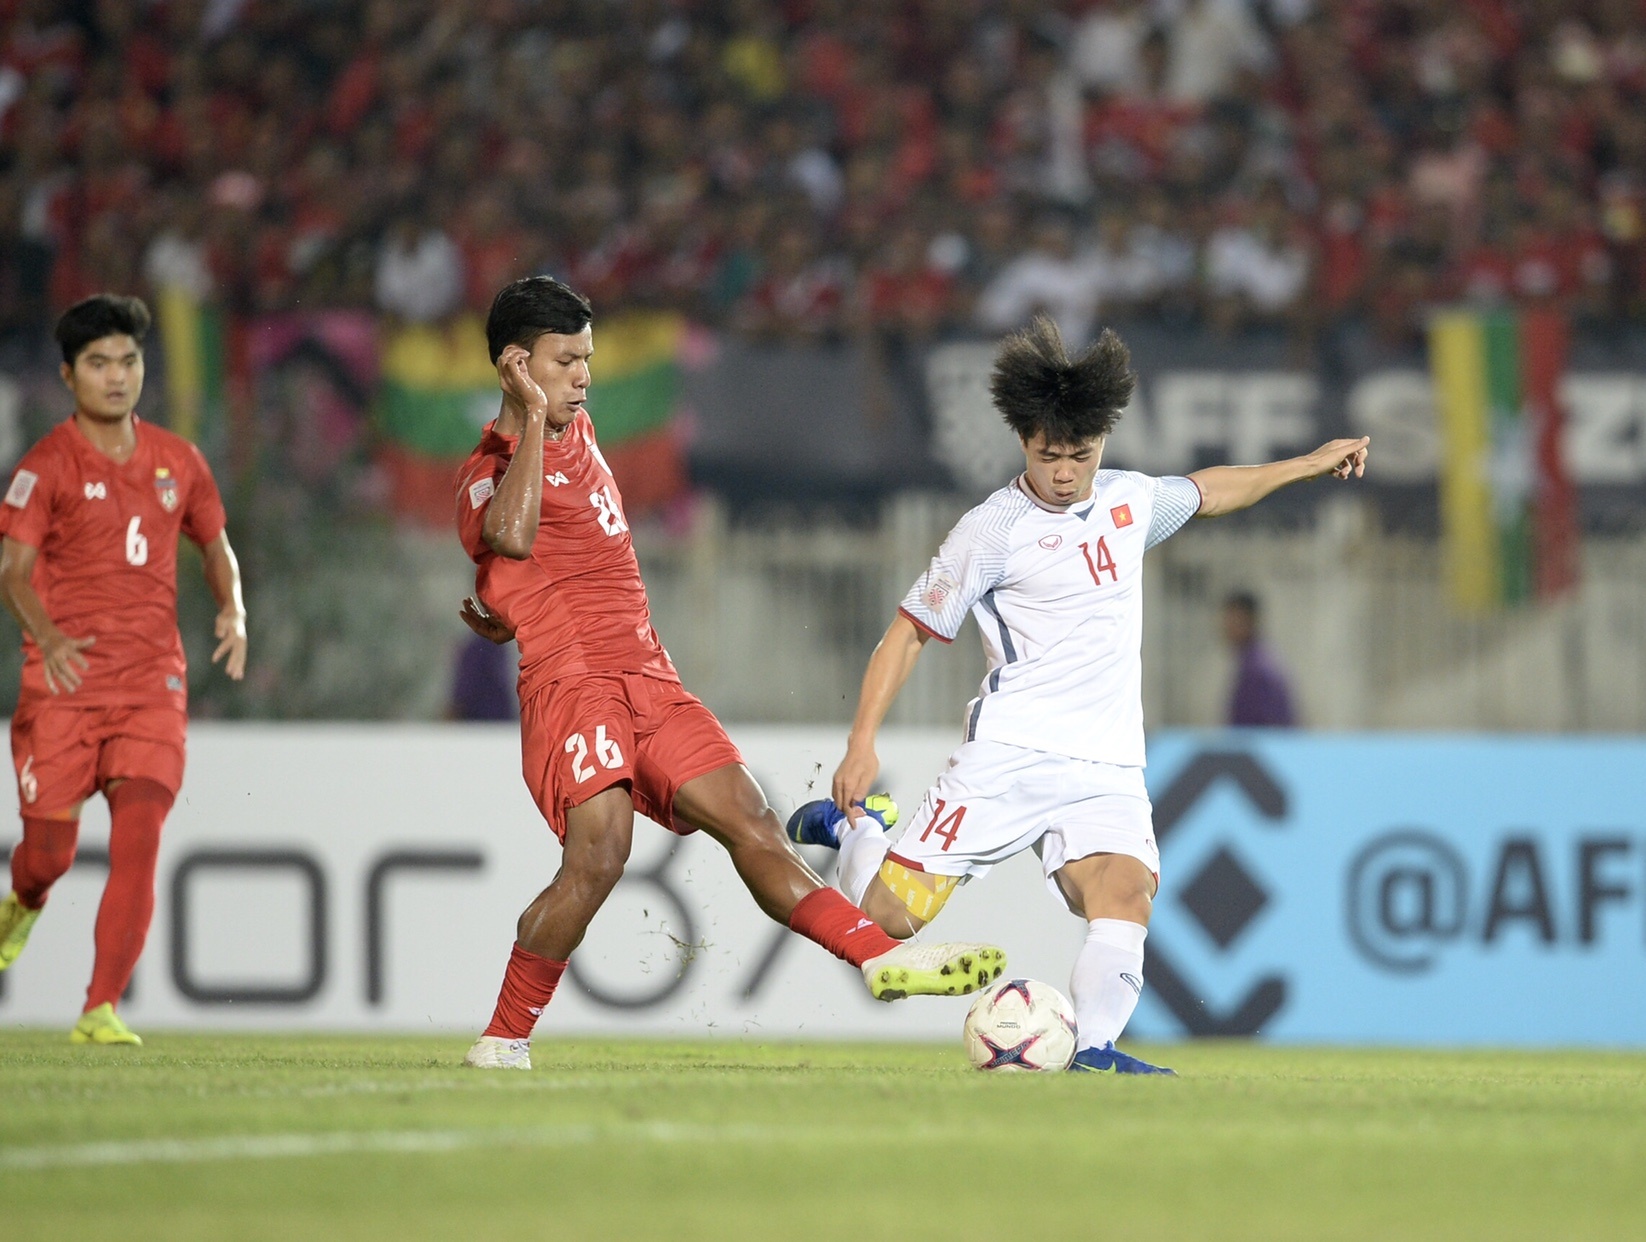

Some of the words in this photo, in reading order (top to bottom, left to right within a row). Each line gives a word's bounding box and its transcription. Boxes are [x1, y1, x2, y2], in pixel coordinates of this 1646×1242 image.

[126, 515, 148, 567] 6
[1078, 535, 1118, 587] 14
[20, 755, 38, 803] 6
[564, 724, 624, 784] 26
[919, 798, 967, 852] 14
[1343, 827, 1646, 976] @AF
